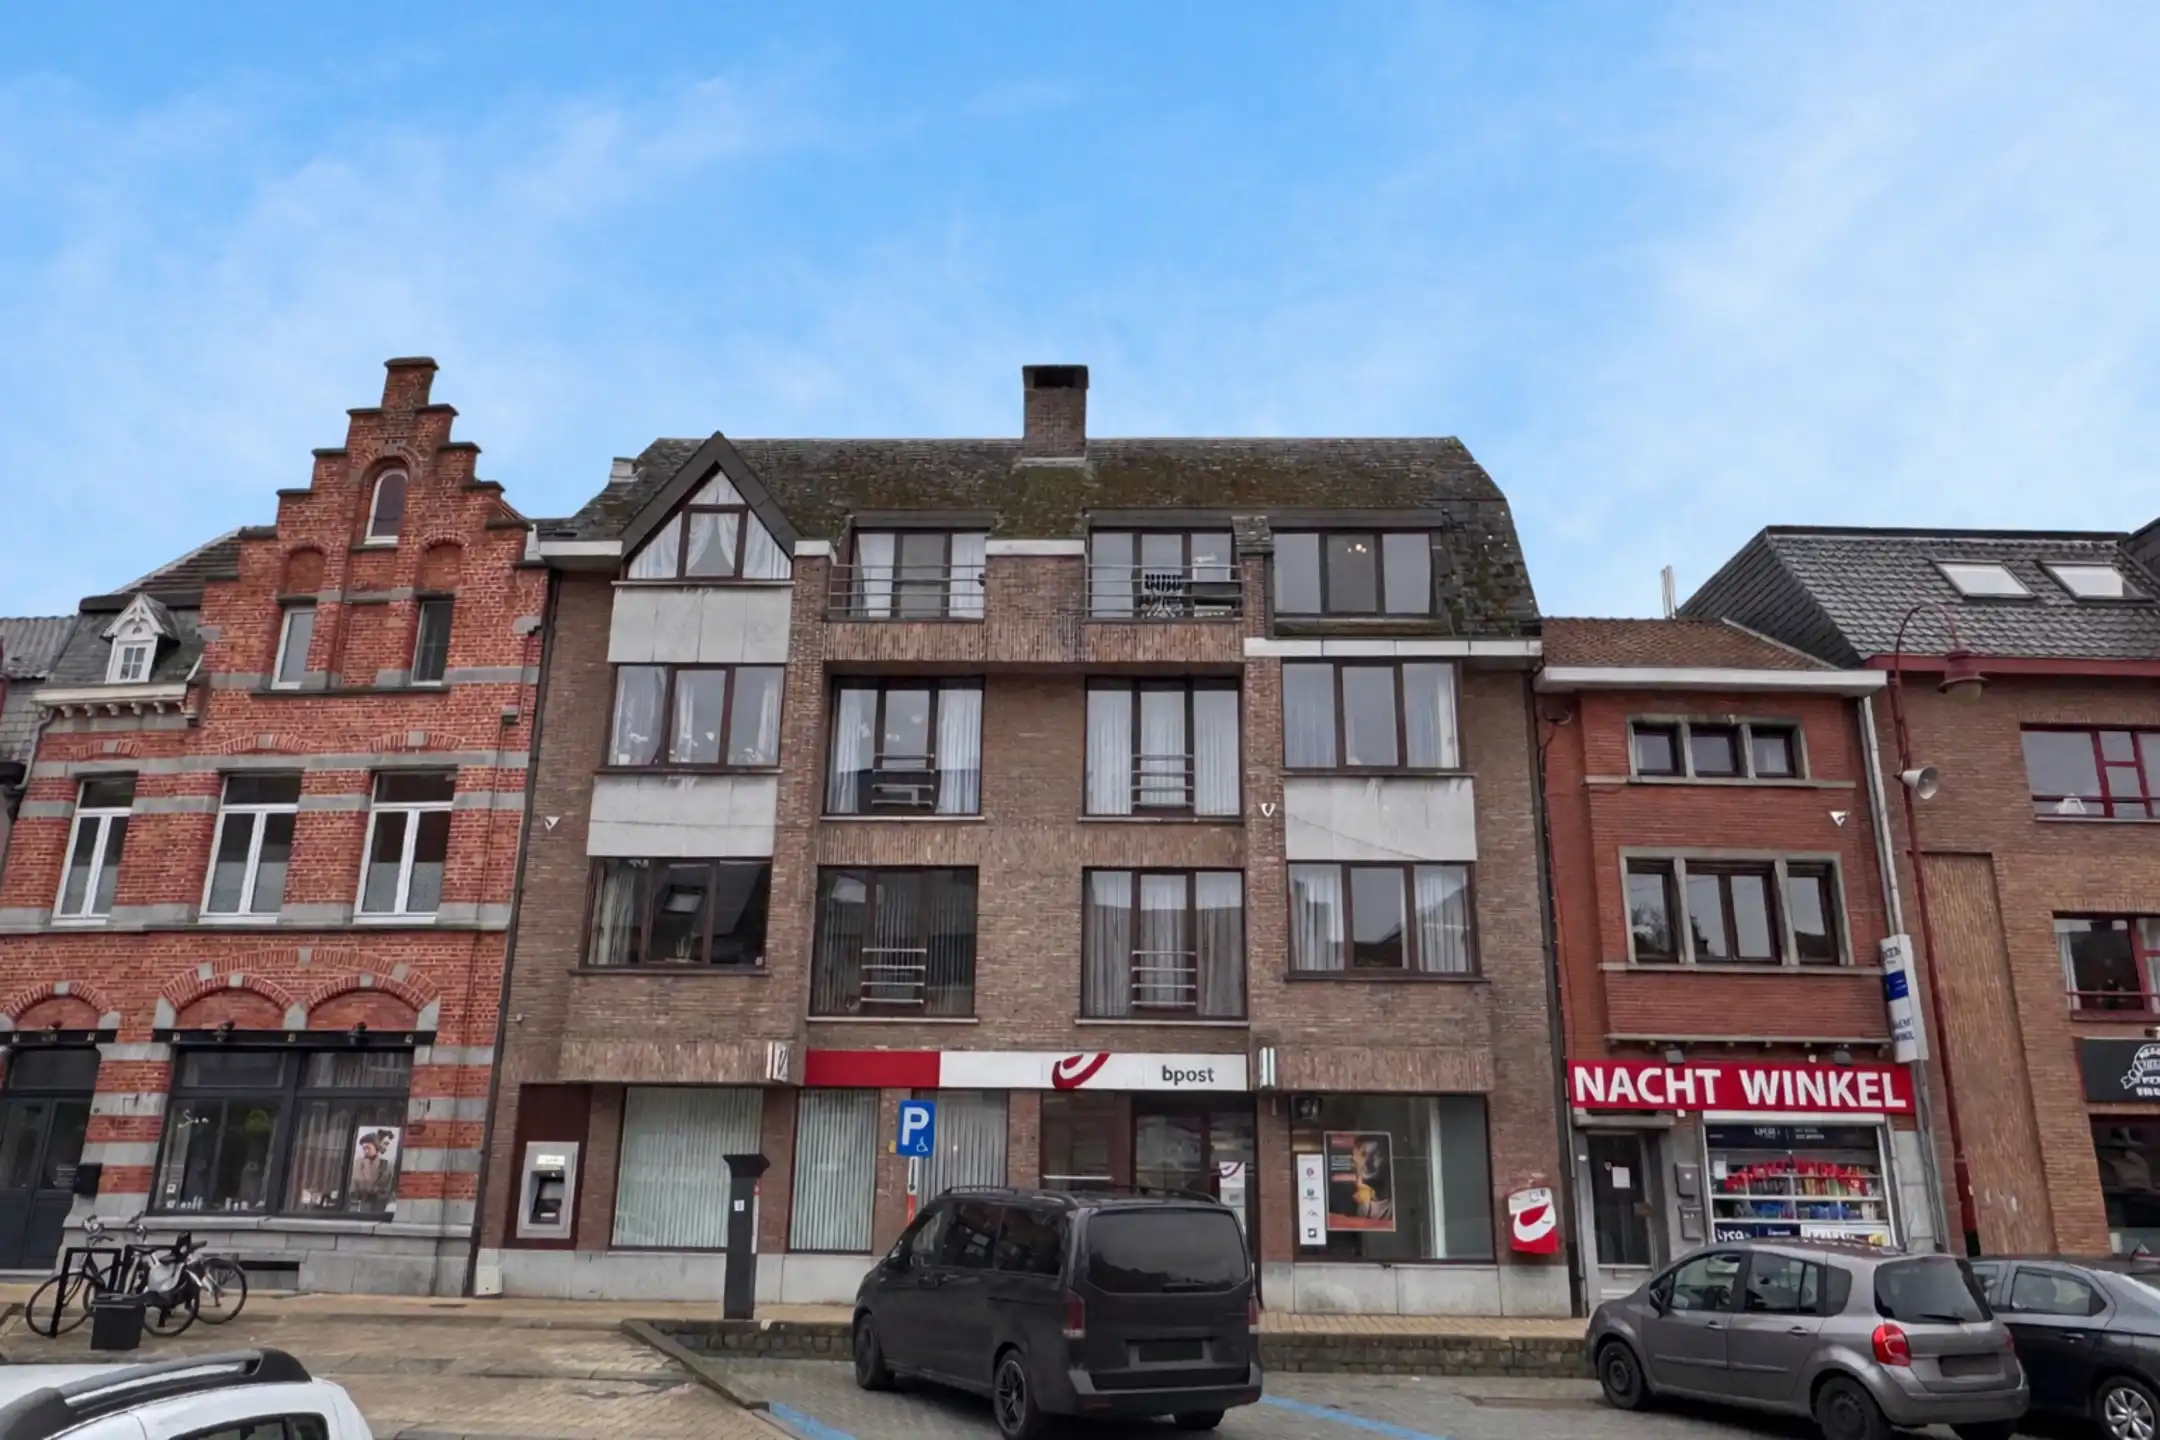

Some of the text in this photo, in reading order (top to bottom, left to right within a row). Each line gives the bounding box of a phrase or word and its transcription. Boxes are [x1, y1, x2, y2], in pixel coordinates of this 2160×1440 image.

[1161, 1065, 1215, 1085] bpost
[1573, 1066, 1907, 1108] NACHT WINKEL
[902, 1107, 930, 1146] P
